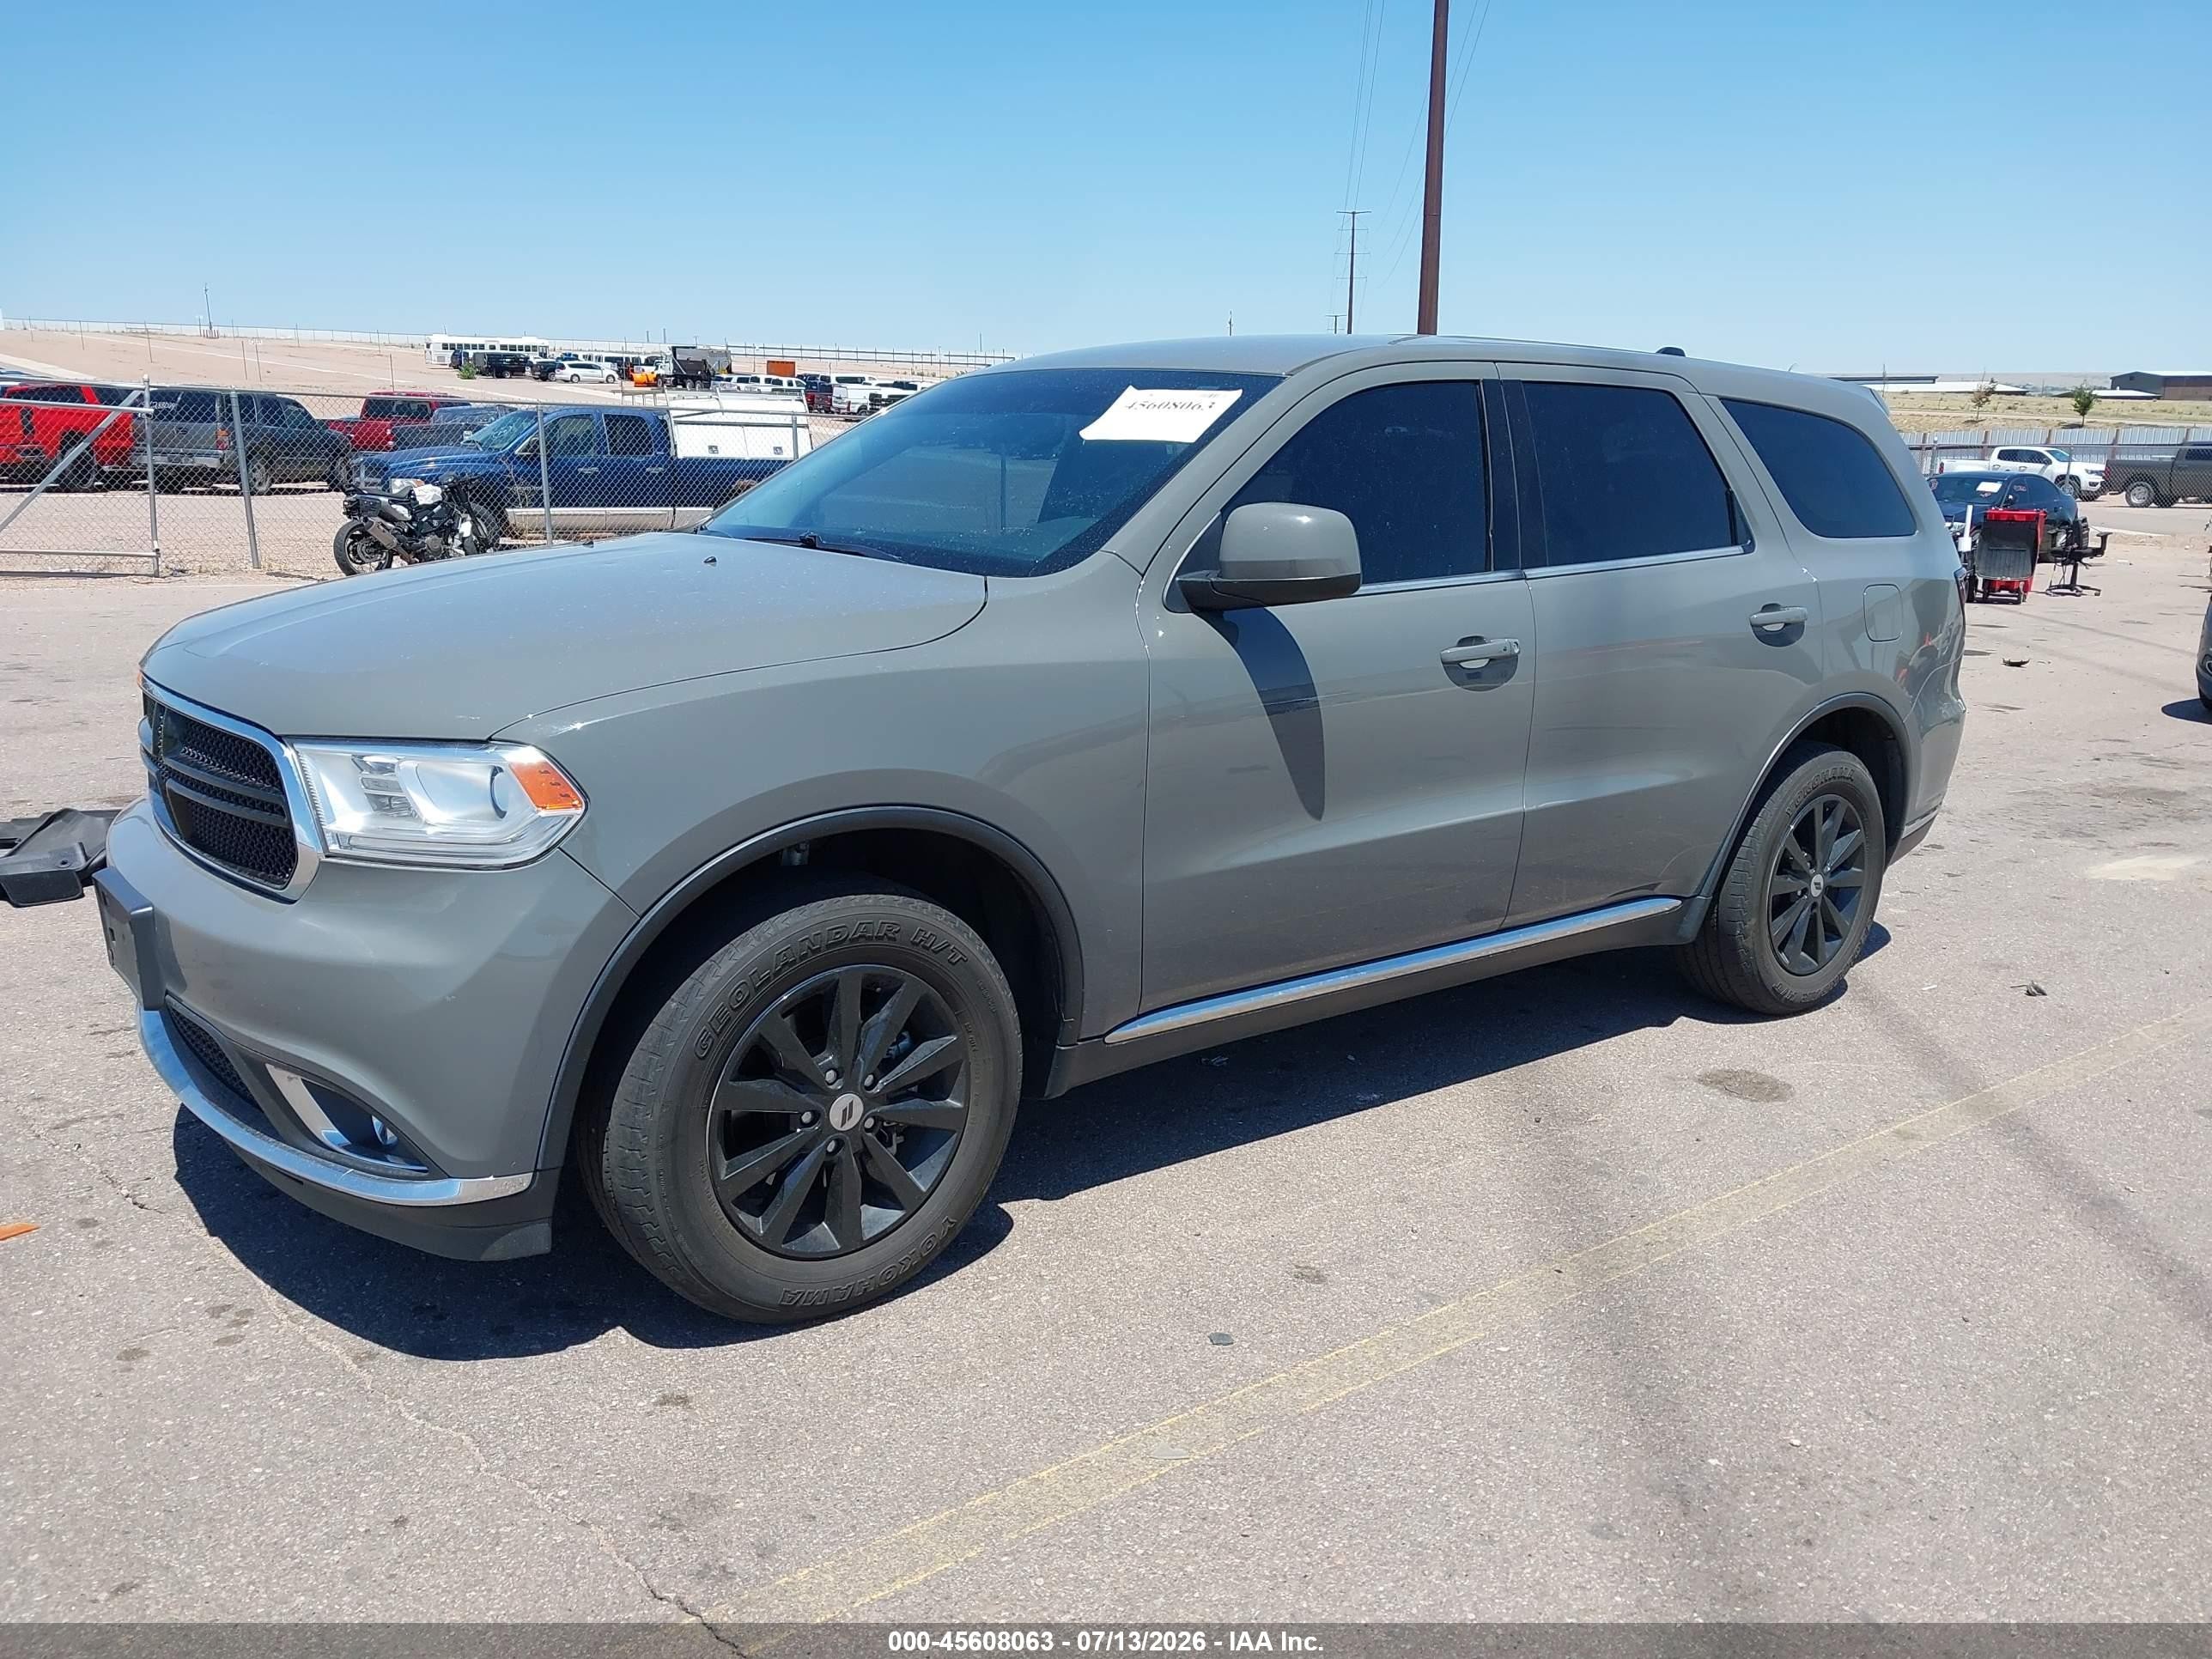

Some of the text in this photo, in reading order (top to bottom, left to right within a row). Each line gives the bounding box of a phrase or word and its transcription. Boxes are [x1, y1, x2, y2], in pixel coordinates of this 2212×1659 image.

[693, 920, 968, 1060] GEOLANDAR H/T
[778, 1215, 957, 1306] YOKOHAMA
